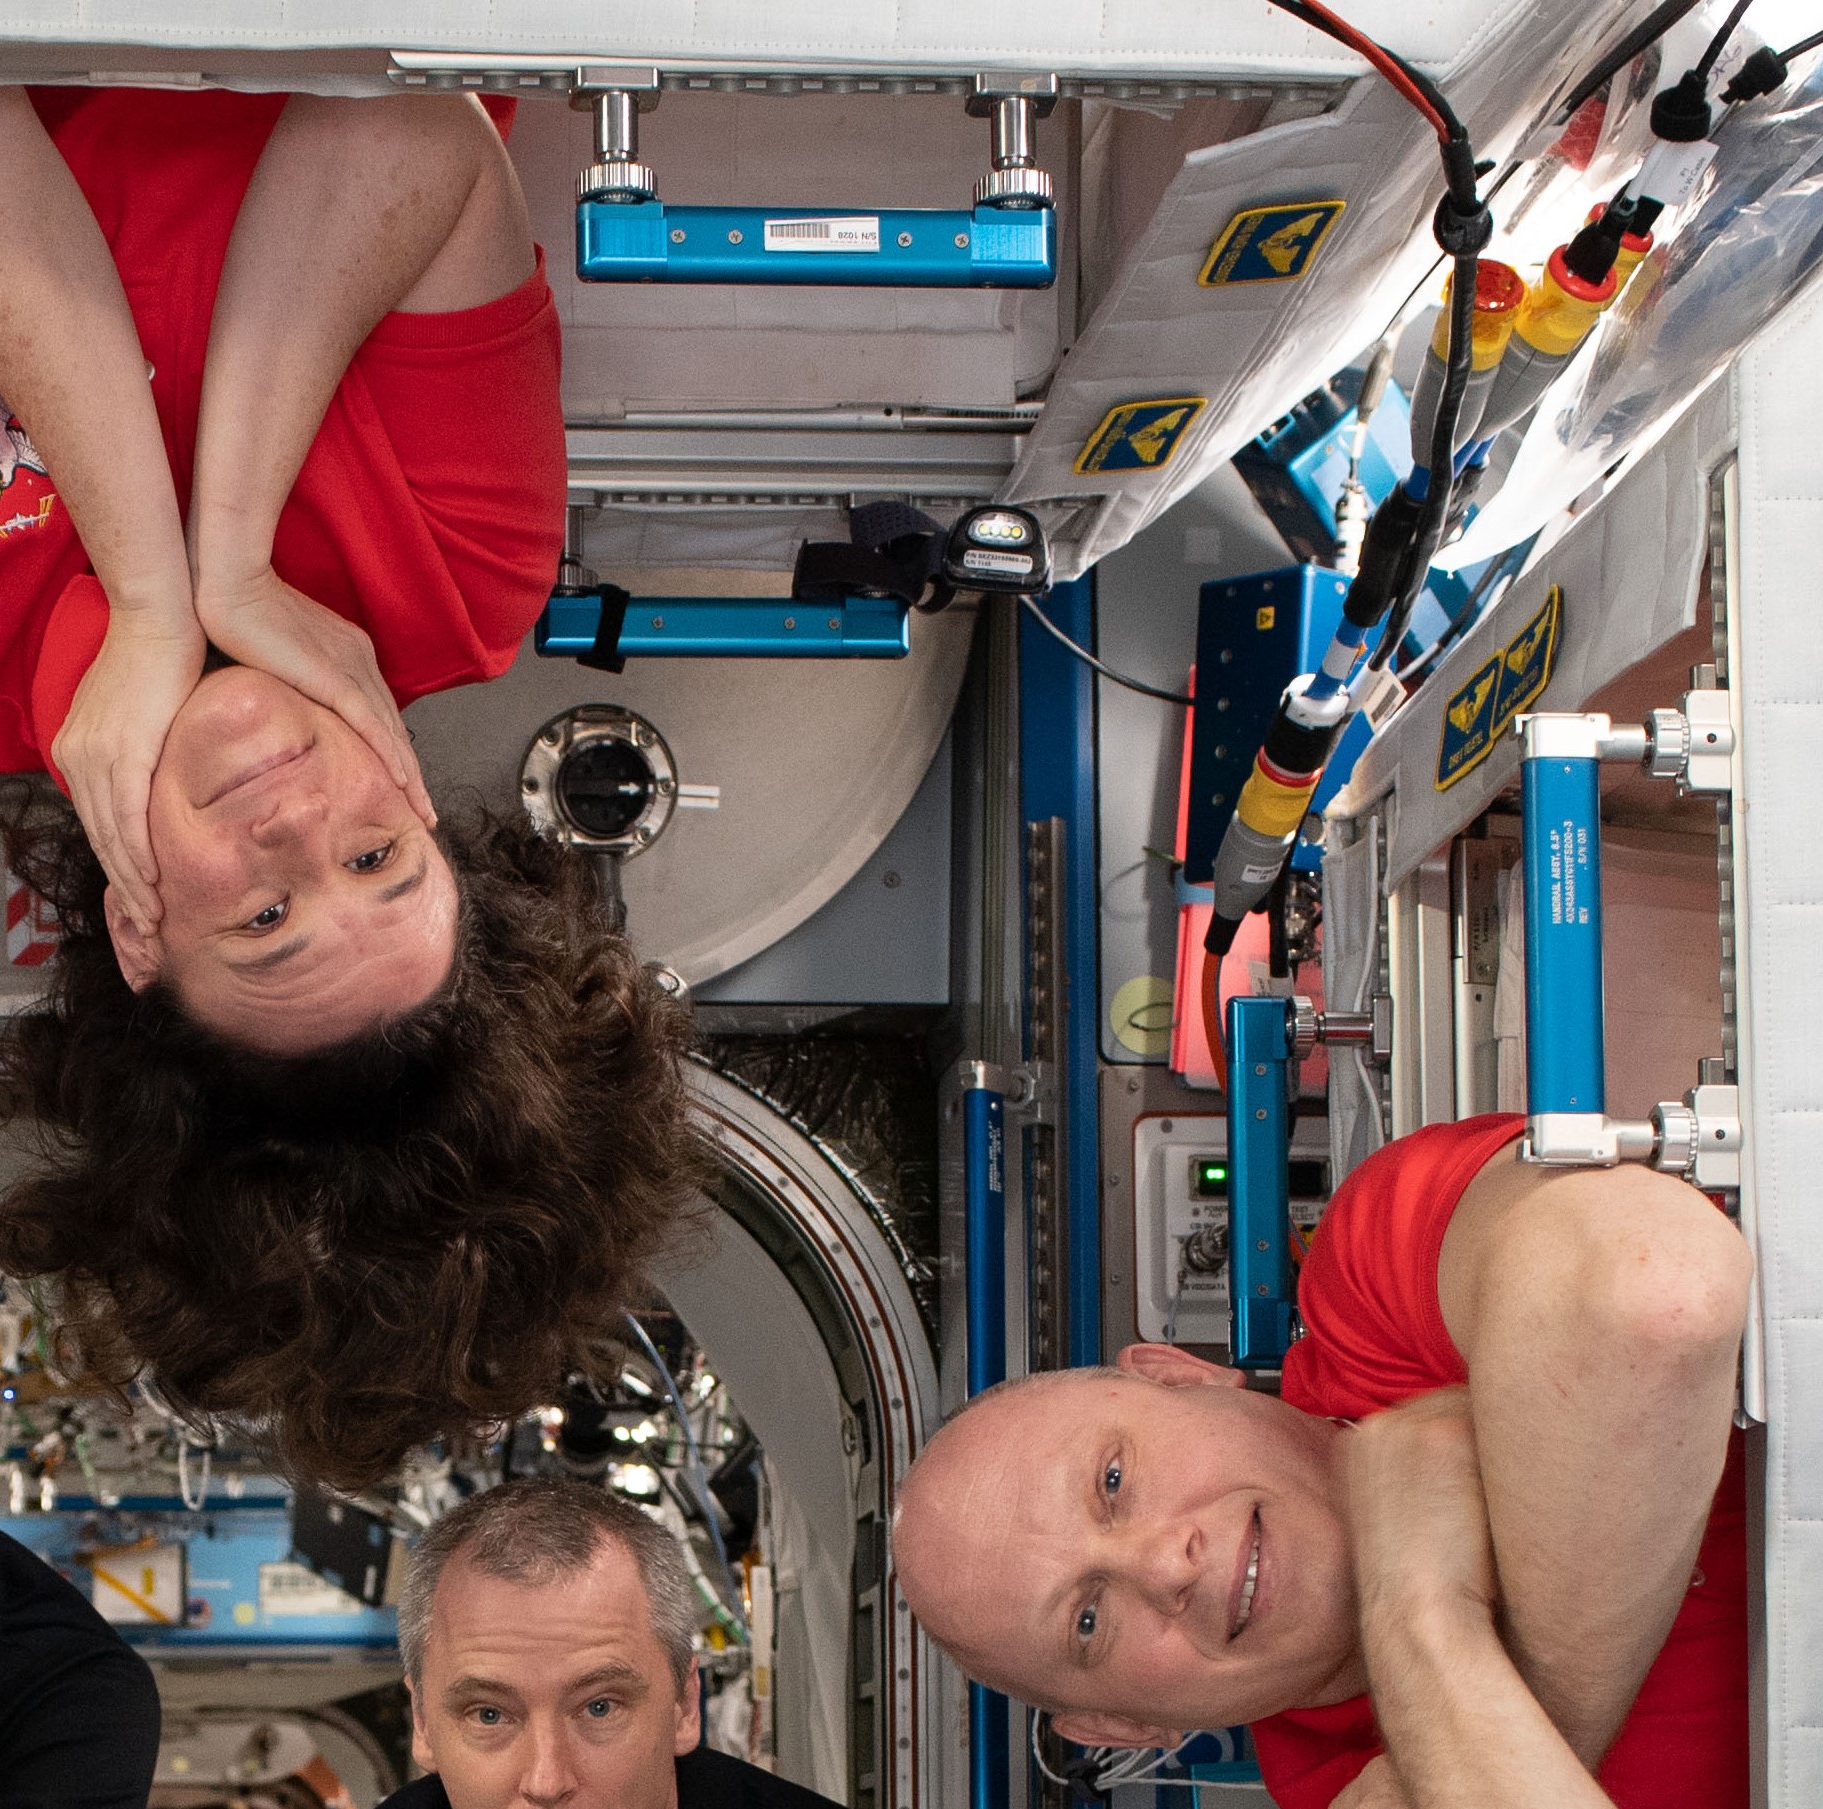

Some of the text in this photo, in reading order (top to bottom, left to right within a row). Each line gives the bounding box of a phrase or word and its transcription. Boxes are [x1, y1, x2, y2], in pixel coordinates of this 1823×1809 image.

[837, 231, 876, 239] S/N 1028
[1551, 881, 1560, 923] HANDRAIL
